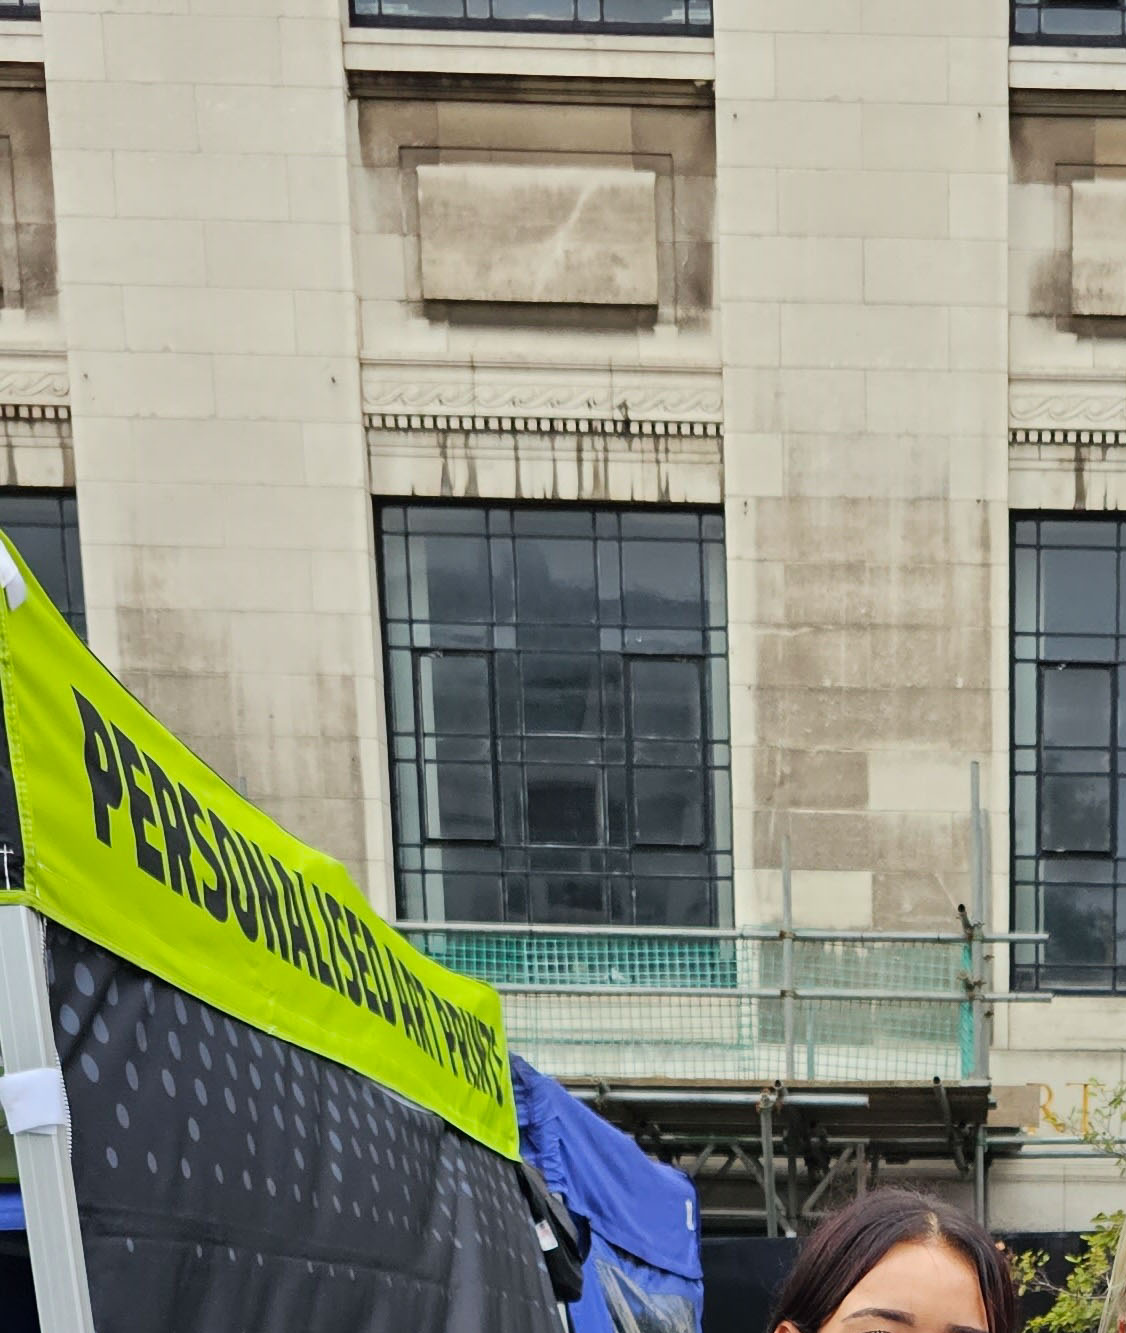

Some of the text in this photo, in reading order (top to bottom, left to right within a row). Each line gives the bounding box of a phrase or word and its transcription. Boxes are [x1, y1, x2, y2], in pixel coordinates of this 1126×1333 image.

[71, 685, 503, 1107] PERSONALISED ART PRINTS
[1026, 1083, 1106, 1136] RT
